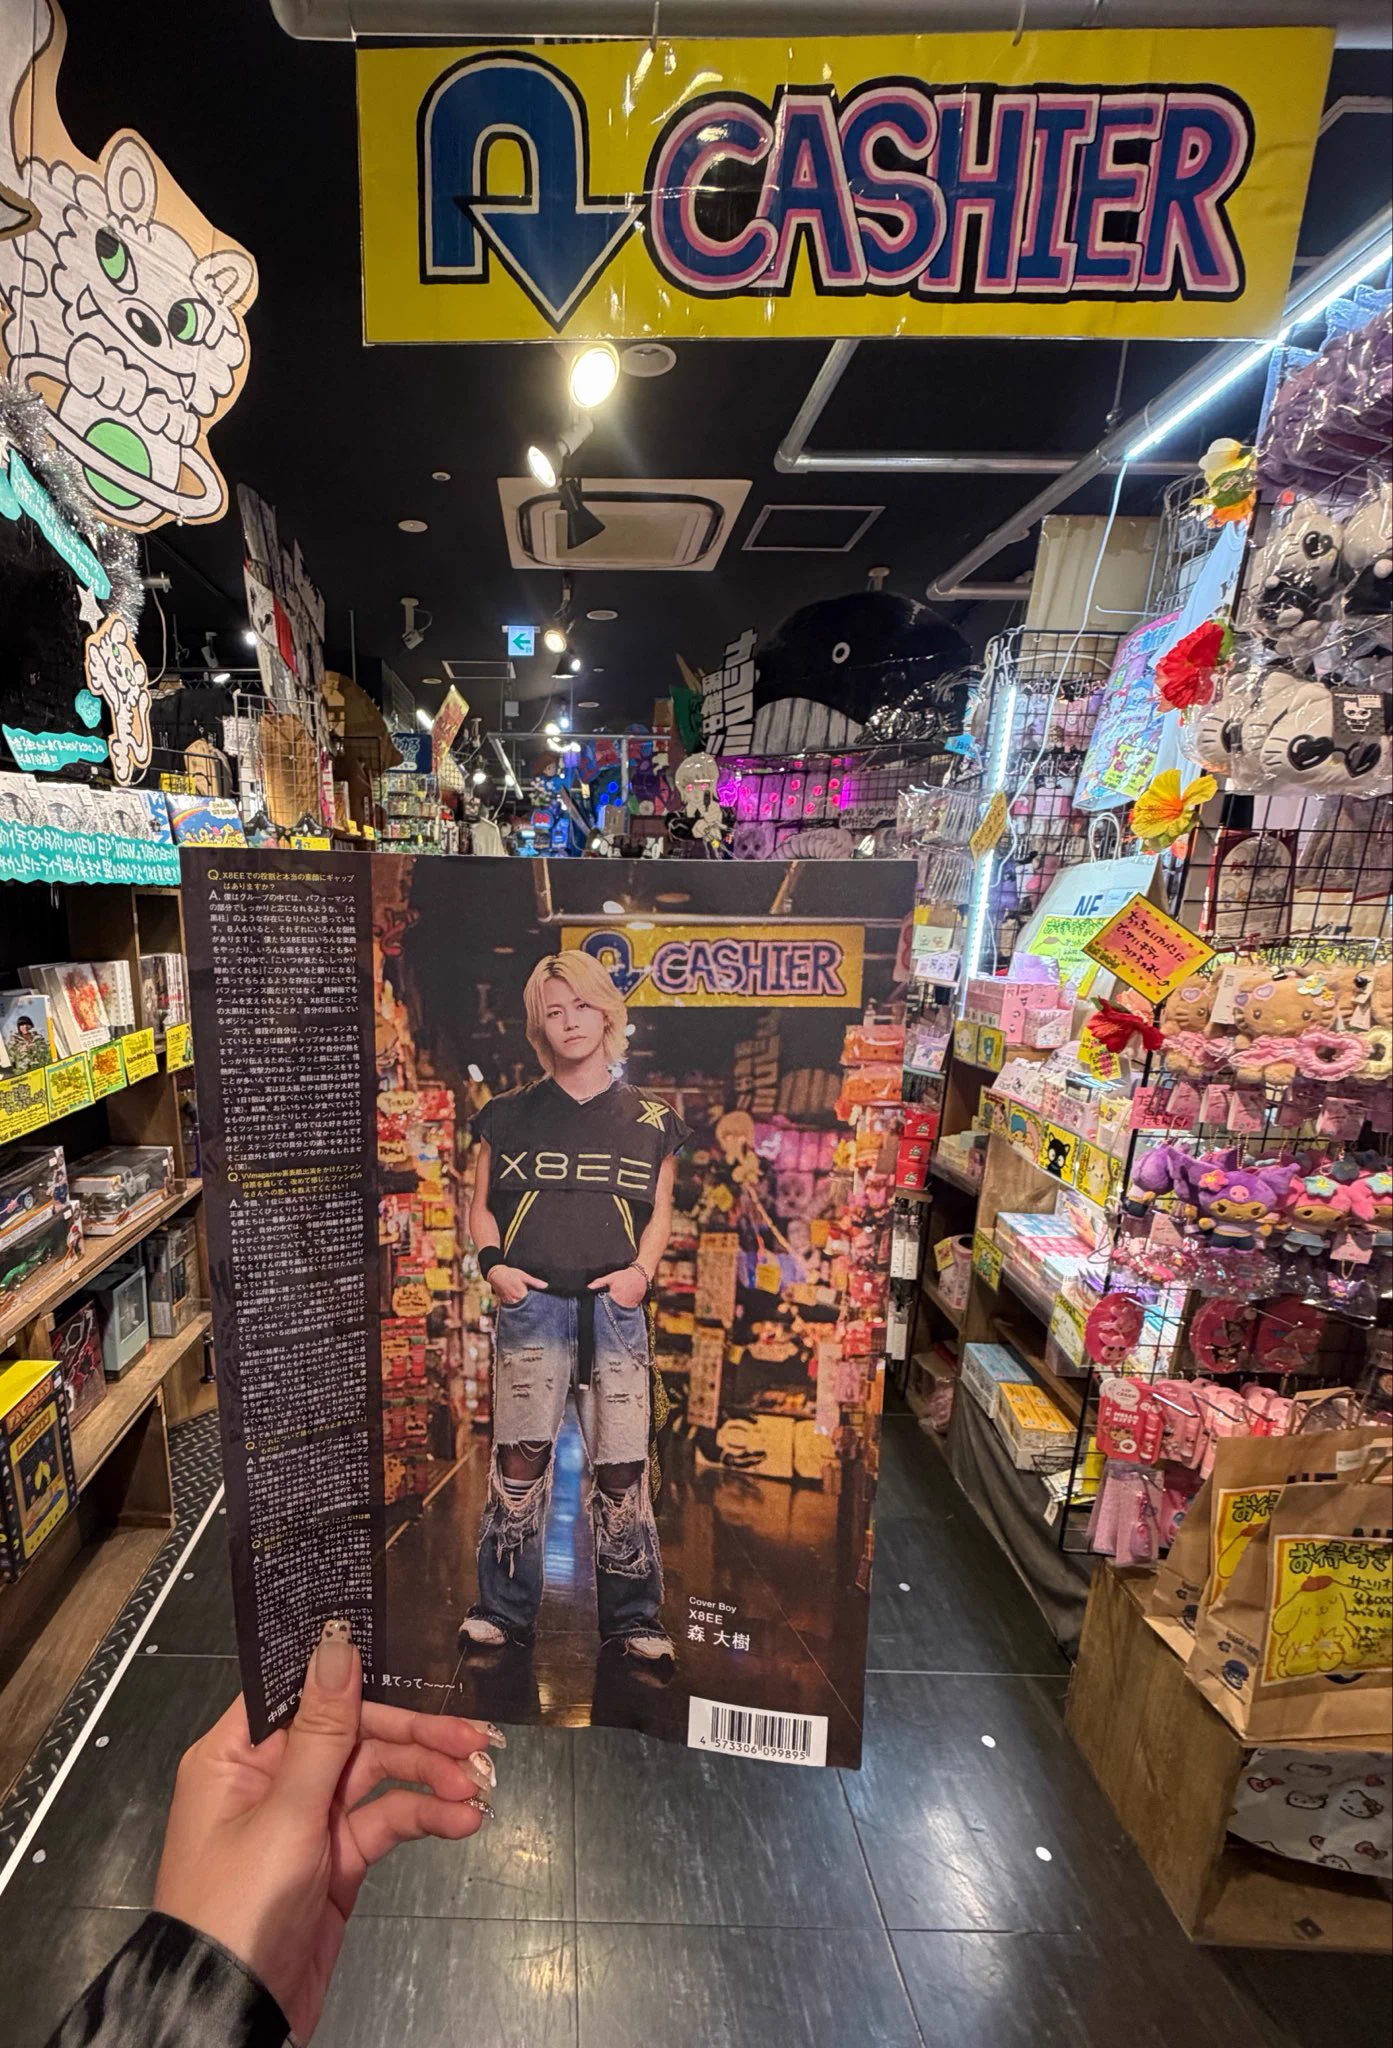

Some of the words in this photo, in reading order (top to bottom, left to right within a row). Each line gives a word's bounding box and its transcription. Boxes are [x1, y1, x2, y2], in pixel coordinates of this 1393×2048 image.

[648, 77, 1253, 301] CASHIER
[652, 938, 847, 996] CASHIER
[500, 1151, 652, 1190] X8EE
[688, 1596, 716, 1610] Cover
[718, 1602, 737, 1614] Boy
[688, 1609, 724, 1625] X8EE
[687, 1624, 706, 1643] 森
[713, 1630, 751, 1652] 大樹
[700, 1736, 706, 1745] 4
[715, 1739, 757, 1754] 573306
[763, 1745, 806, 1760] 099895
